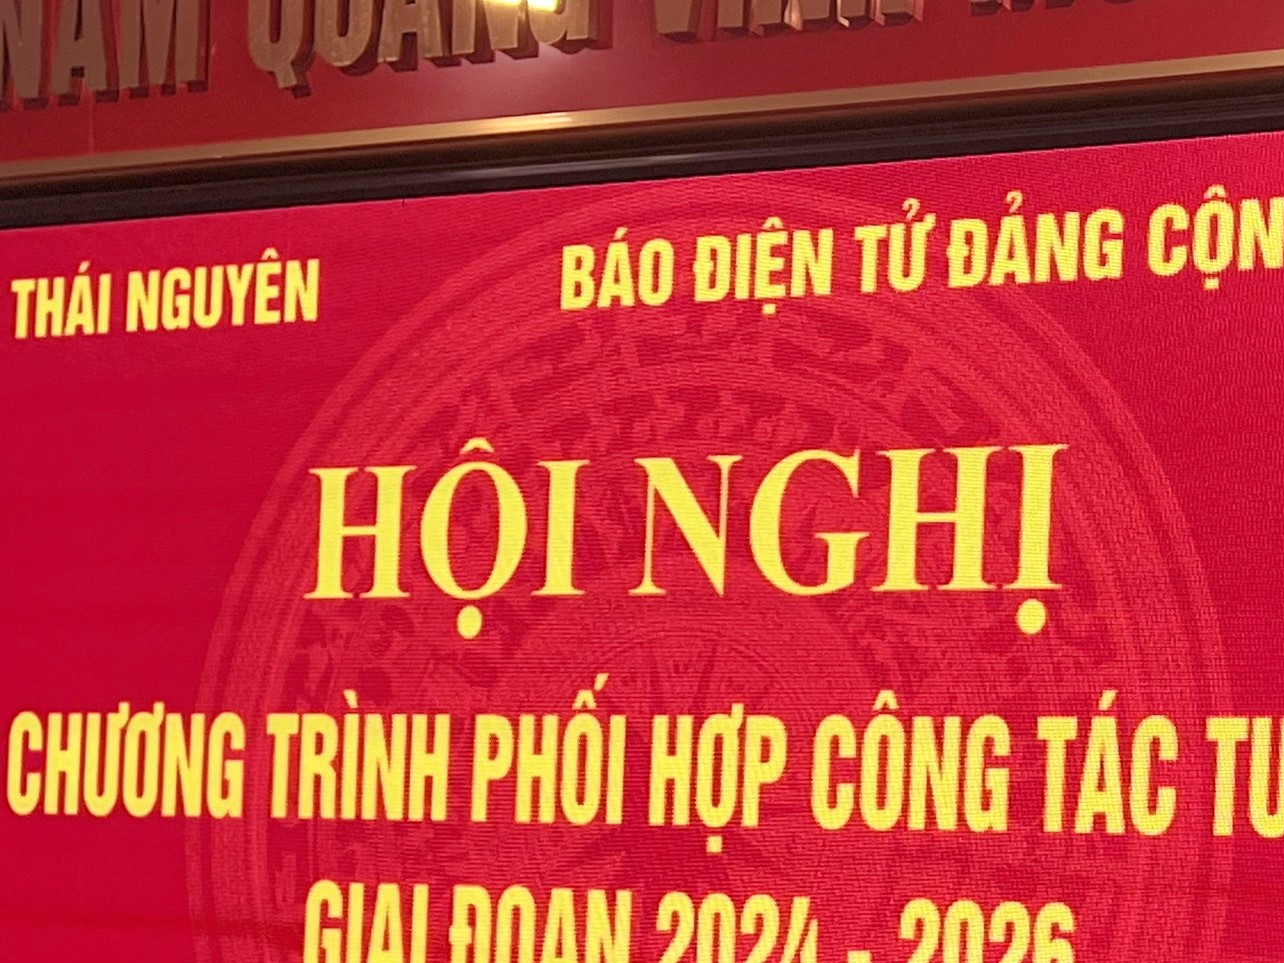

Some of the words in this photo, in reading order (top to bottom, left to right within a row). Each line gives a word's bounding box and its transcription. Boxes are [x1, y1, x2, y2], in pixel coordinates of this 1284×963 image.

[11, 261, 111, 340] THÁI
[126, 247, 320, 333] NGUYÊN
[560, 226, 675, 311] BÁO
[692, 216, 834, 315] ĐIỆN
[853, 197, 937, 293] TỬ
[945, 190, 1124, 290] ĐẢNG
[303, 437, 591, 640] HỘI
[627, 443, 1069, 635] NGHỊ
[7, 701, 246, 819] CHƯƠNG
[266, 689, 451, 822] TRÌNH
[470, 673, 628, 826] PHỐI
[648, 702, 789, 853] HỢP
[811, 689, 1013, 833] CÔNG
[1036, 689, 1180, 837] TÁC
